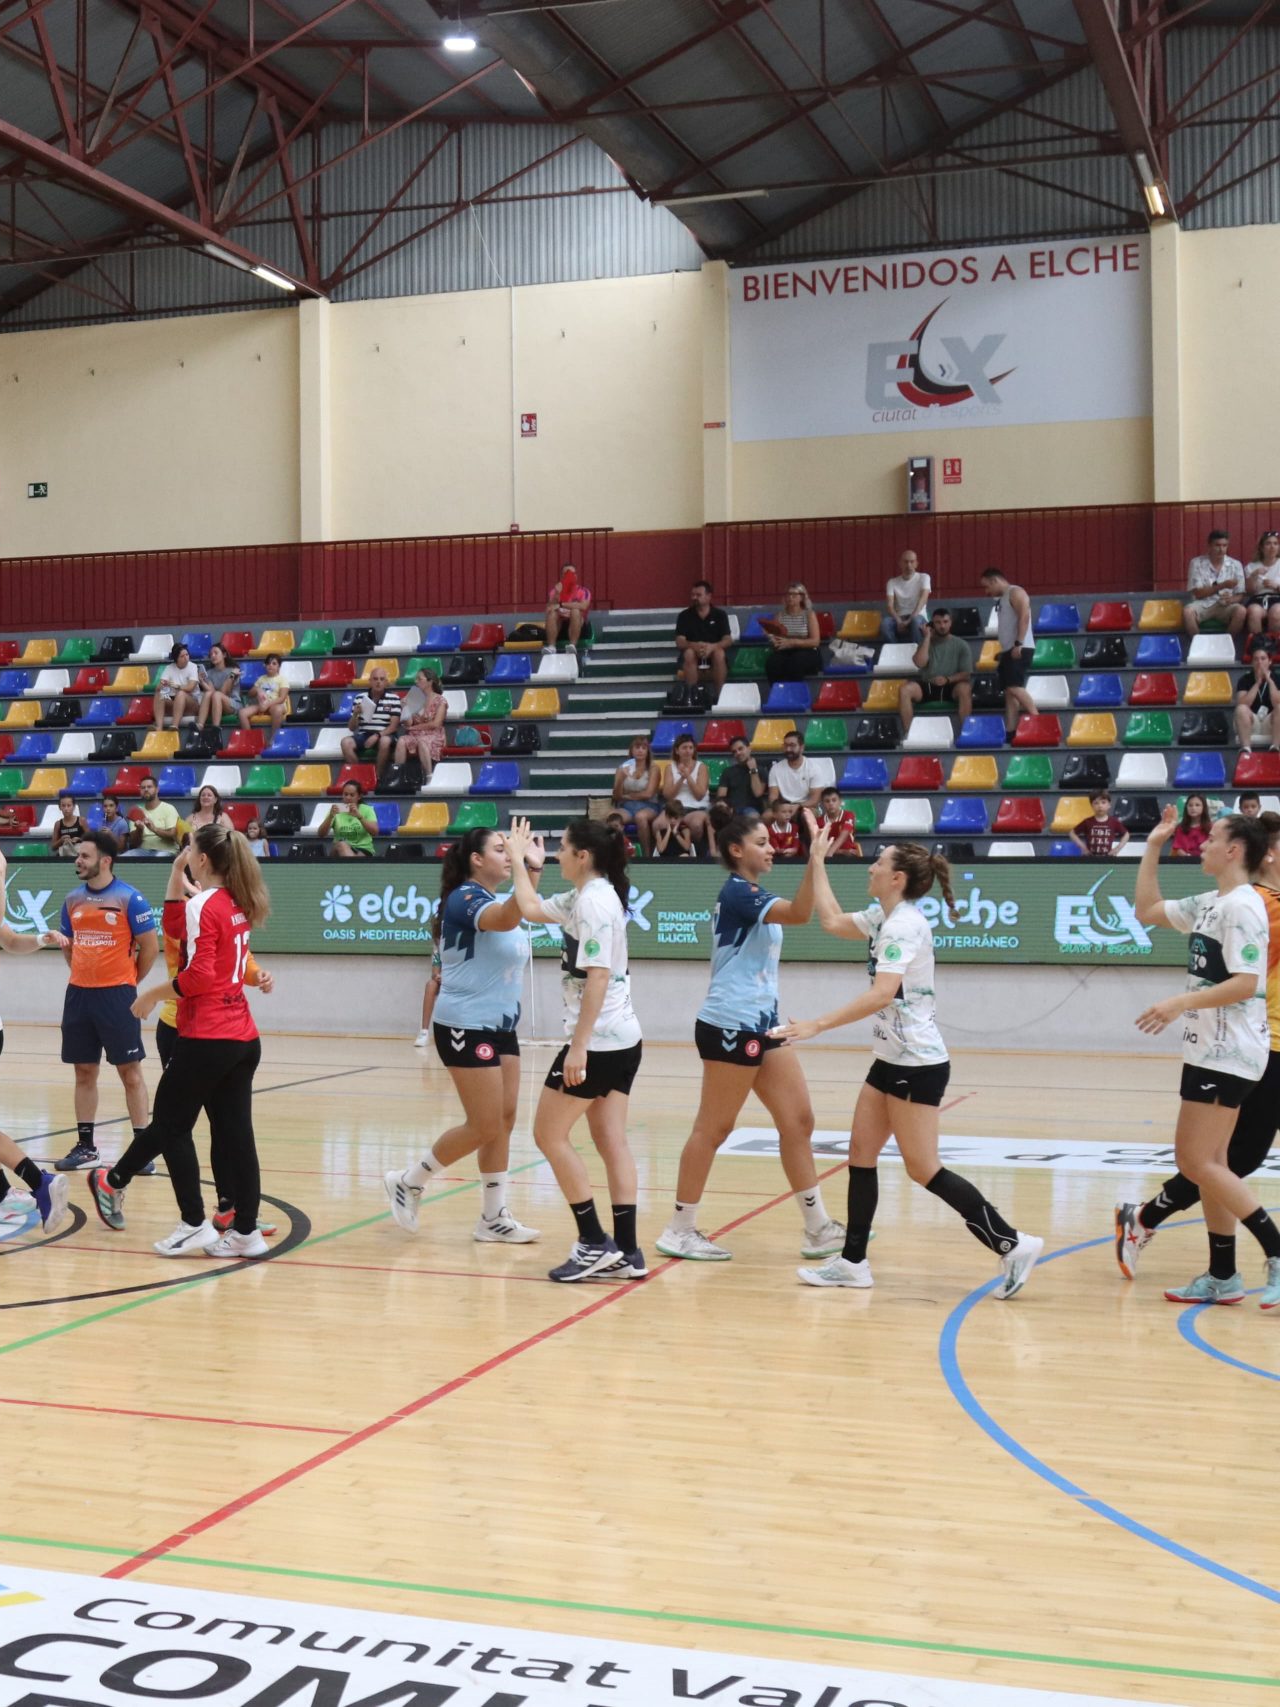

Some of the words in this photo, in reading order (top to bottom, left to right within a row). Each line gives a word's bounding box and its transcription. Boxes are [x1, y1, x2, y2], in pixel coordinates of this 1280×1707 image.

[743, 256, 978, 301] BIENVENIDOS
[991, 254, 1016, 282] A
[1029, 243, 1140, 280] ELCHE
[872, 408, 918, 423] ciutat
[657, 909, 711, 922] FUNDACIÓ
[323, 928, 356, 940] OASIS
[657, 923, 696, 932] ESPORT
[933, 933, 1019, 948] DITERRÁNEO
[73, 1597, 631, 1690] Comunitat
